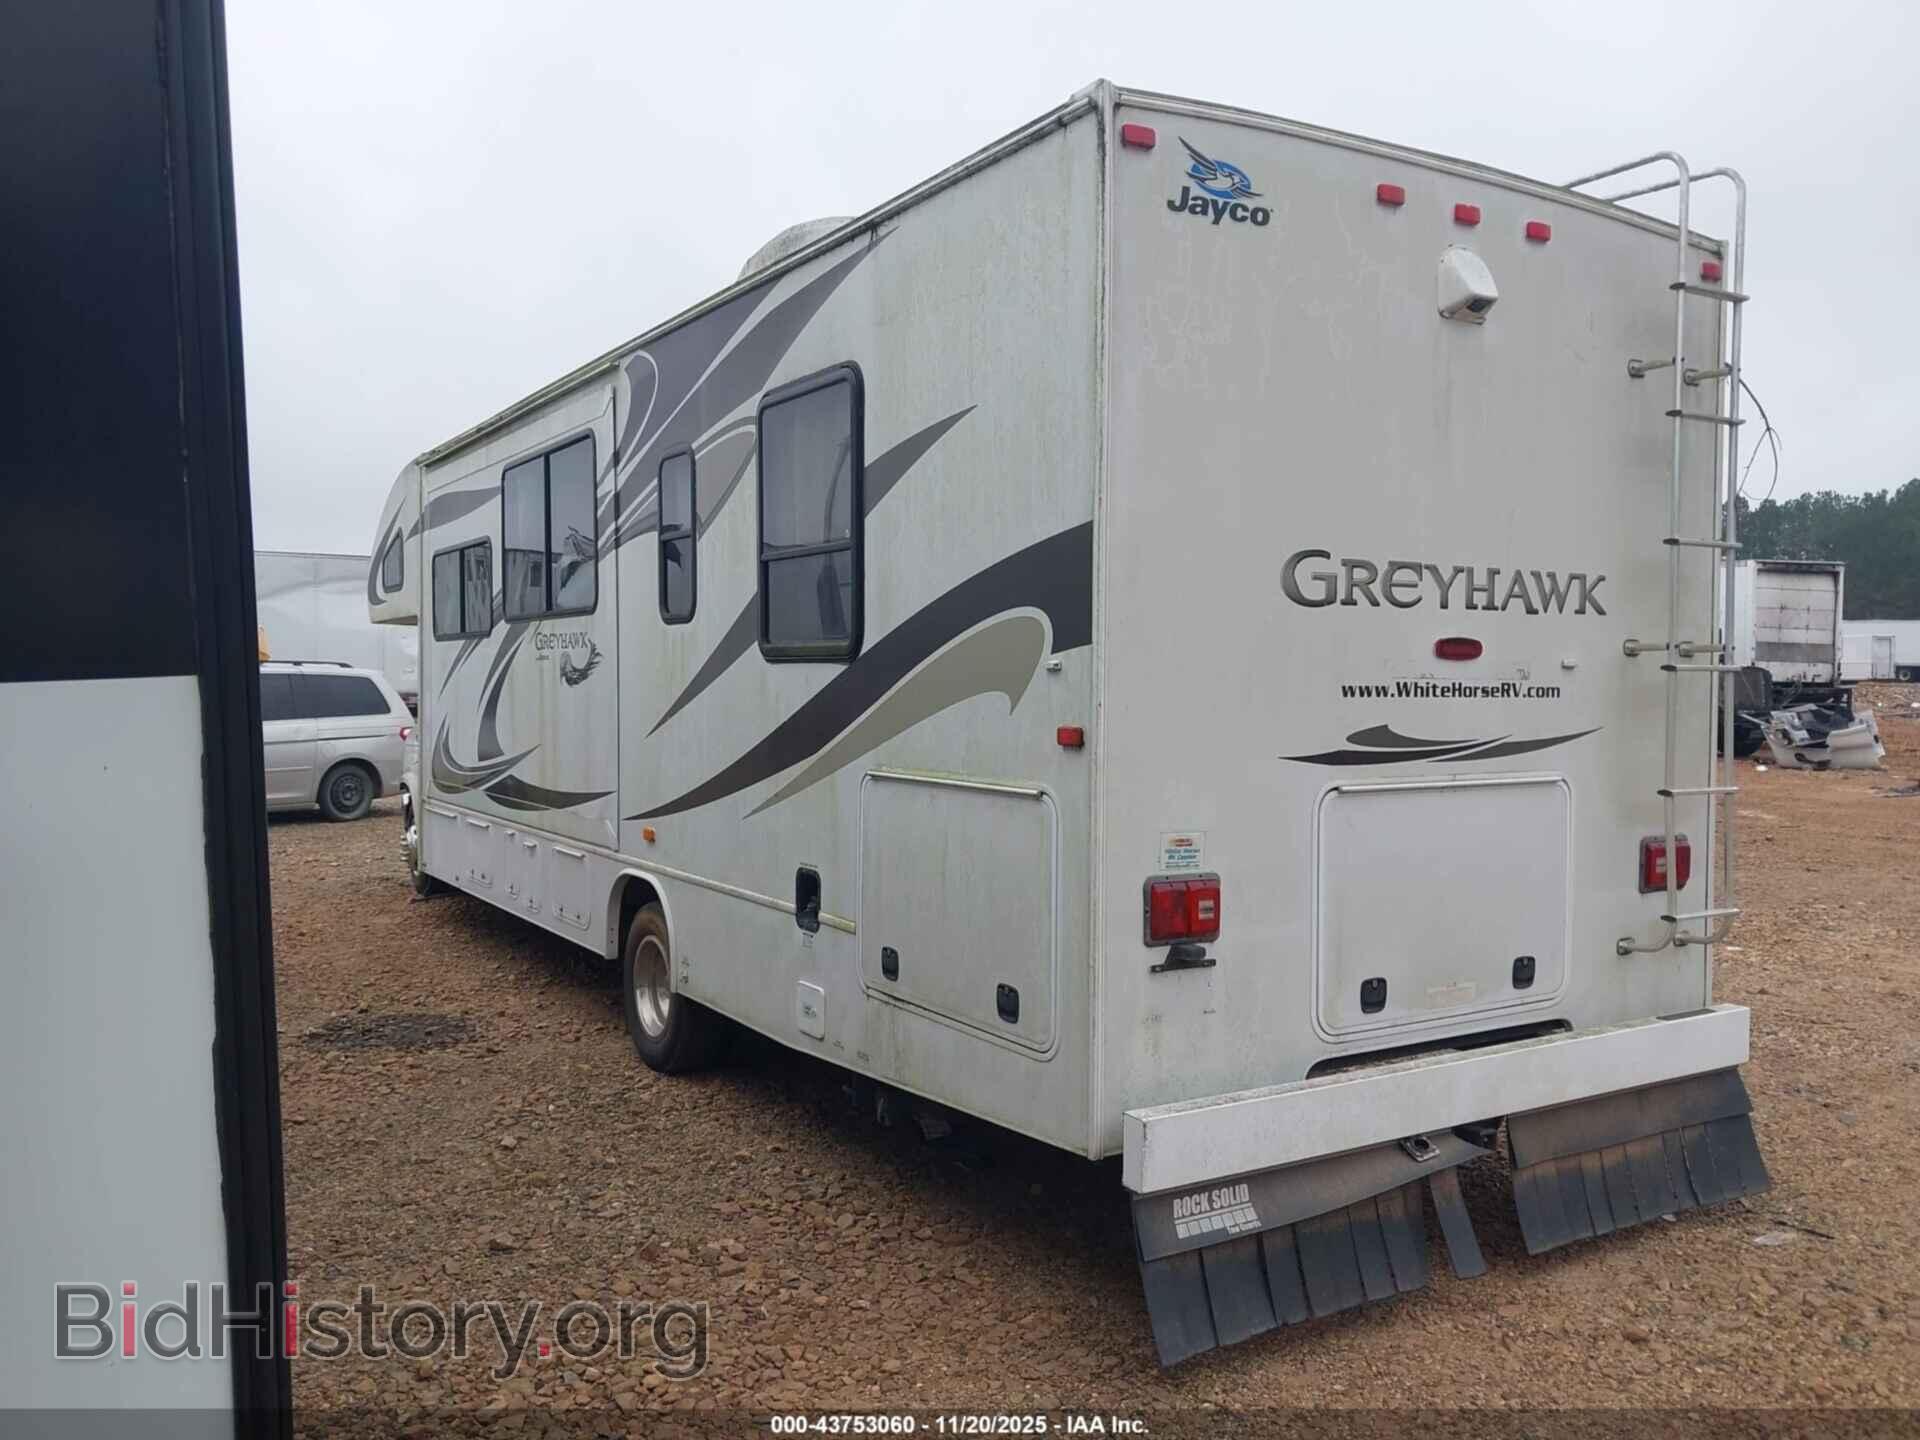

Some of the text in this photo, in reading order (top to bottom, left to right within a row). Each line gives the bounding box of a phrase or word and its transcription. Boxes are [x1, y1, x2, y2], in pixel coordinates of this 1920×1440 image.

[1167, 186, 1271, 226] Jayco
[1280, 549, 1607, 616] GREYHAWK
[535, 631, 589, 651] GREYHAWK
[1341, 681, 1561, 698] www.WhiteHorseRV.com
[1173, 1184, 1250, 1218] ROCK SOLID
